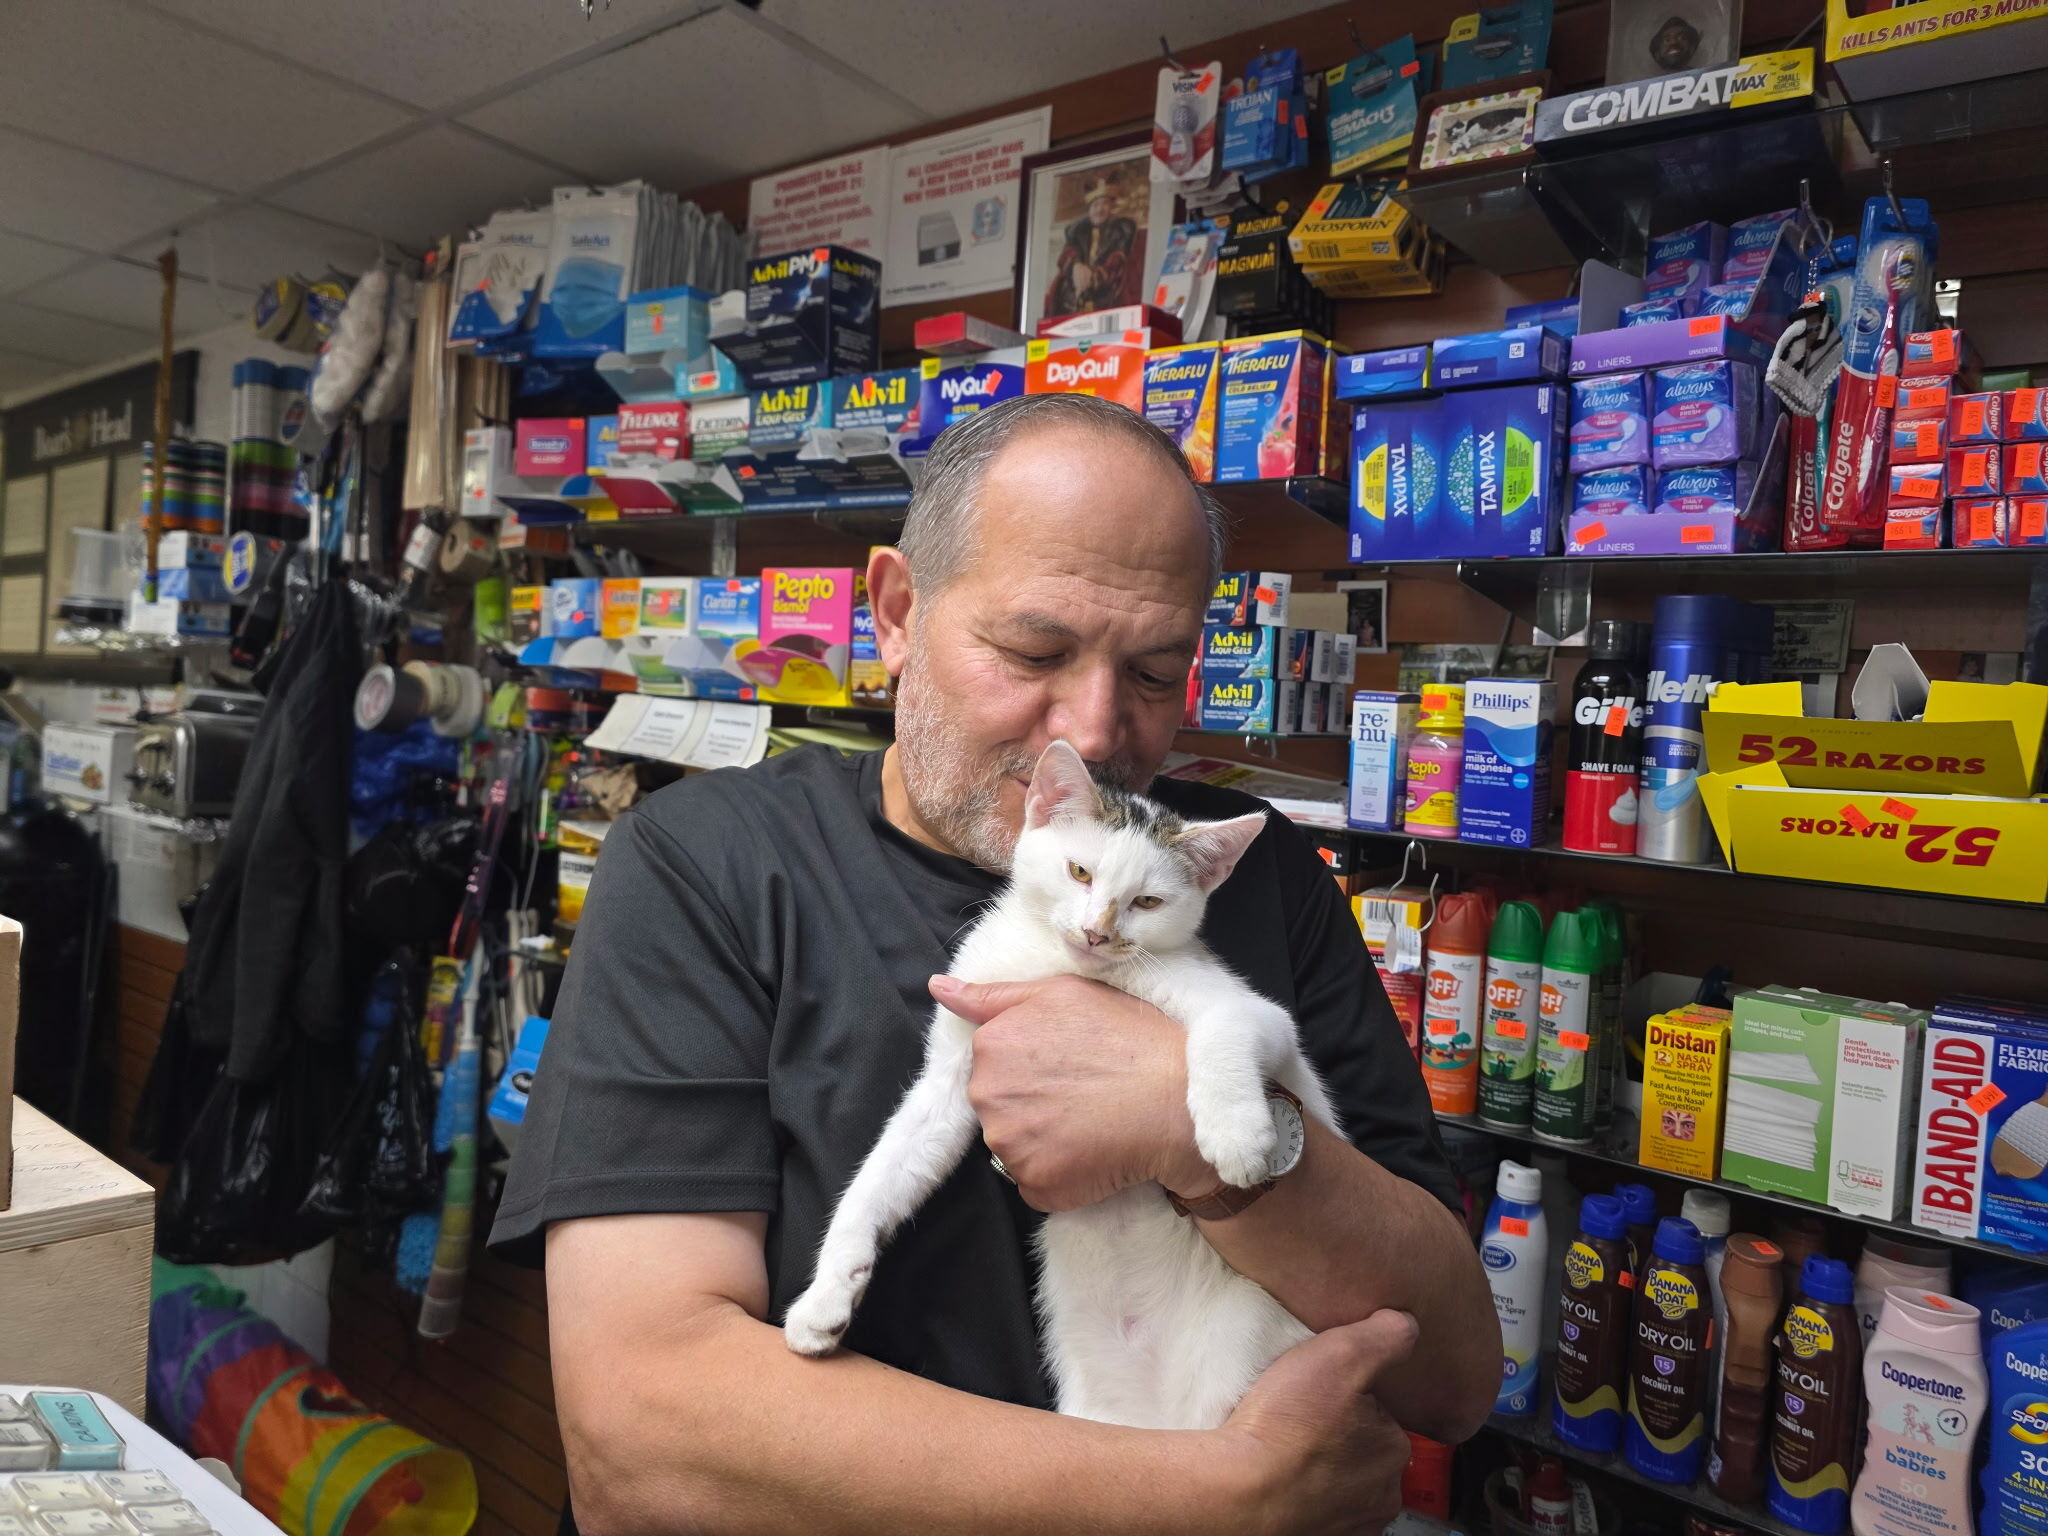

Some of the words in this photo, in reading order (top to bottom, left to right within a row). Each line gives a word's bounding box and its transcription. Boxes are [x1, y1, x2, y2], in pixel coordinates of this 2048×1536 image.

[1841, 27, 1888, 50] KILLS
[1890, 17, 1939, 39] ANTS
[1942, 8, 1979, 29] FOR
[1979, 4, 1992, 20] 3
[1730, 73, 1768, 94] MAX
[1776, 73, 1801, 85] SMALL
[1230, 87, 1273, 112] TROJAN
[1563, 63, 1753, 131] COMBAT
[975, 146, 1000, 162] MUST
[947, 167, 969, 182] YORK
[1236, 215, 1283, 234] MAGNUM
[1302, 219, 1392, 233] NEOSPORIN
[1655, 239, 1697, 260] always
[752, 261, 788, 283] Advil
[788, 253, 816, 275] PM
[1218, 252, 1276, 275] MAGNUM
[1688, 346, 1719, 356] UNSCENTED
[1046, 355, 1120, 386] DayQuil
[1227, 353, 1290, 375] THERAFLU
[1572, 360, 1586, 371] 20
[1597, 356, 1632, 369] LINERS
[1148, 364, 1207, 384] THERAFLU
[1900, 376, 1942, 388] Colgate
[941, 376, 992, 403] NyQu
[1227, 386, 1246, 394] COLD
[1247, 383, 1272, 392] RELIEF
[1664, 380, 1715, 399] always
[755, 385, 811, 414] Advil
[1583, 391, 1631, 410] always
[620, 411, 681, 430] TYLENOL
[1989, 395, 2001, 431] Colgate
[1478, 430, 1498, 516] TAMPAX
[1825, 422, 1855, 510] Colgate
[1987, 449, 1999, 485] Colgate
[1391, 443, 1409, 518] TAMPAX
[1583, 480, 1632, 497] always
[1668, 473, 1720, 491] always
[1801, 451, 1815, 532] Colgate
[1889, 507, 1930, 518] Colgate
[1993, 501, 2006, 537] Colgate
[1597, 543, 1636, 552] LINERS
[1696, 543, 1729, 551] UNSCENTED
[773, 573, 835, 603] Pepto
[772, 599, 810, 614] Bismol
[1209, 632, 1253, 647] Advil
[1209, 683, 1253, 699] Advil
[1359, 728, 1387, 743] nu
[1465, 754, 1486, 763] milk
[1487, 755, 1498, 763] of
[1737, 733, 1819, 767] 52
[1825, 750, 1986, 776] RAZORS
[1408, 758, 1441, 775] Pepto
[1465, 764, 1513, 774] magnesia
[1581, 761, 1610, 773] SHAVE
[1612, 763, 1636, 774] FOAM
[1904, 823, 2002, 867] 52
[1428, 976, 1463, 999] OFF!
[1486, 983, 1524, 1007] OFF!
[1541, 990, 1565, 1013] FF!
[1491, 1008, 1517, 1019] DEEP
[1744, 1019, 1760, 1028] Ideal
[1760, 1021, 1770, 1029] for
[1770, 1024, 1790, 1033] minor
[1744, 1025, 1769, 1036] scrapes,
[1769, 1030, 1782, 1038] and
[1650, 1025, 1716, 1055] Dristan
[1844, 1037, 1868, 1047] Gentle
[1677, 1051, 1713, 1066] NASAL
[1843, 1044, 1882, 1057] protection
[1843, 1050, 1856, 1058] the
[1856, 1052, 1872, 1060] hurt
[1872, 1054, 1900, 1065] doesn't
[1999, 1043, 2048, 1063] FLEXIB
[1676, 1060, 1713, 1073] SPRAY
[1843, 1056, 1859, 1065] hold
[1860, 1060, 1874, 1068] you
[1874, 1061, 1893, 1070] back
[1649, 1080, 1664, 1091] Fast
[1665, 1084, 1690, 1096] Acting
[1691, 1088, 1713, 1099] Relief
[1655, 1090, 1676, 1101] Sinus
[1676, 1095, 1683, 1103] &
[1684, 1096, 1705, 1106] Nasal
[1658, 1098, 1702, 1113] Congestion
[1922, 1036, 1986, 1215] BAND-AID
[1987, 1191, 2024, 1204] Comfortable
[1984, 1225, 1996, 1234] 10
[2015, 1231, 2034, 1239] LARGE
[1567, 1241, 1602, 1269] BANANA
[1567, 1259, 1594, 1277] BOAT
[1649, 1268, 1695, 1296] BANANA
[1653, 1288, 1687, 1305] BOAT
[1505, 1304, 1526, 1316] Spray
[1575, 1304, 1601, 1323] OIL
[1786, 1303, 1830, 1335] BANANA
[1566, 1325, 1577, 1336] 15
[1638, 1321, 1669, 1347] DRY
[1669, 1335, 1697, 1351] OIL
[1789, 1323, 1820, 1344] BOAT
[1577, 1352, 1589, 1363] OIL
[1657, 1359, 1671, 1371] 15
[2005, 1351, 2048, 1380] Coppe
[1641, 1374, 1672, 1393] COCONUT
[1673, 1385, 1686, 1396] OIL
[1799, 1374, 1830, 1397] OIL
[1881, 1361, 1964, 1400] Coppertone
[1788, 1397, 1799, 1409] 15
[1775, 1412, 1801, 1435] COCONUT
[1801, 1427, 1815, 1440] OIL
[1942, 1416, 1960, 1429] #1
[2011, 1409, 2048, 1431] SPO
[1895, 1444, 1938, 1465] water
[1885, 1448, 1947, 1482] babies
[1899, 1478, 1928, 1499] 50
[2003, 1476, 2048, 1499] PERFORMA
[2011, 1471, 2048, 1491] 4-IN-
[1876, 1484, 1948, 1515] HYPOALLERGENIC
[1878, 1492, 1899, 1506] WITH
[1899, 1499, 1922, 1515] ALOE
[1922, 1508, 1944, 1521] AND
[1864, 1491, 1913, 1519] NOURISHING
[1914, 1511, 1951, 1530] VITAMIN
[1951, 1523, 1958, 1531] E
